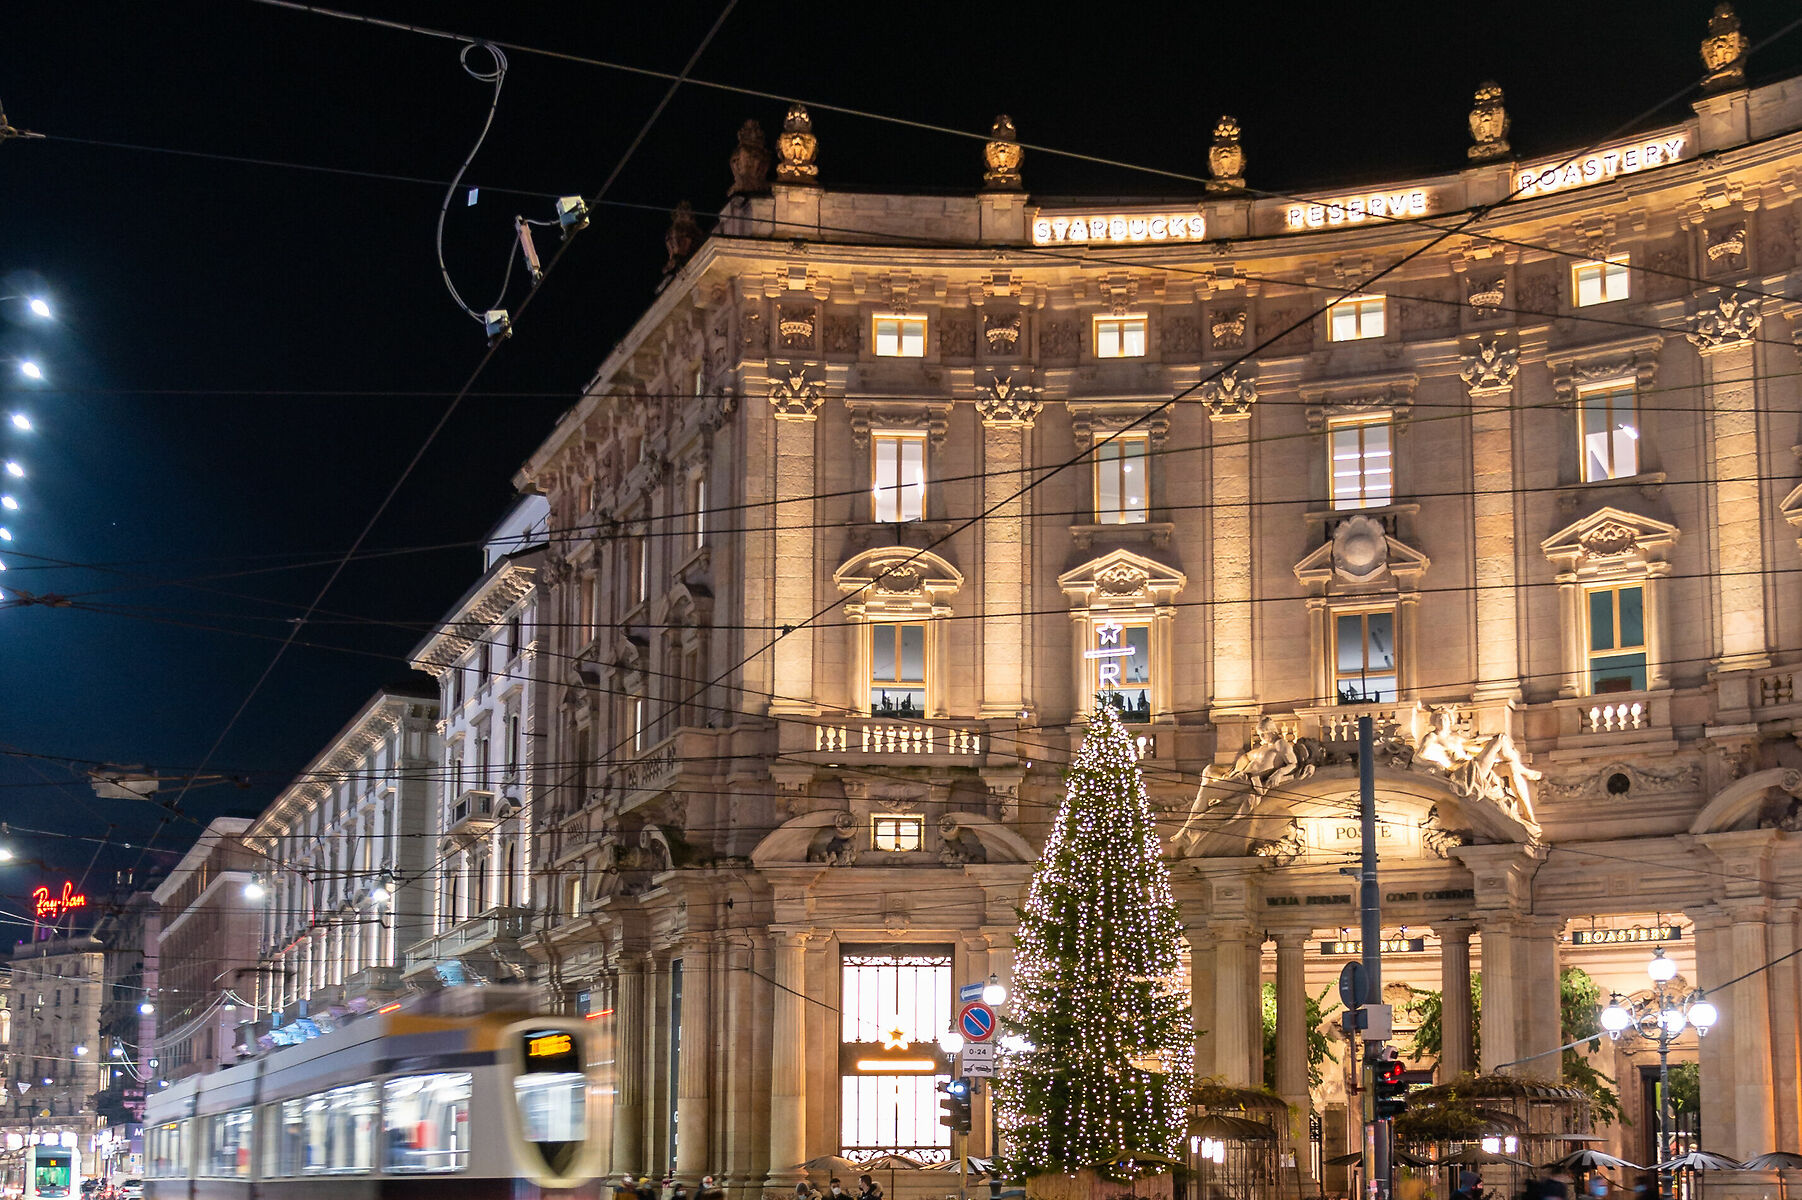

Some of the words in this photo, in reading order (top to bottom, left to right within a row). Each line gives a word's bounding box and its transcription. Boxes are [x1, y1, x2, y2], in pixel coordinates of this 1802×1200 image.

[1520, 139, 1680, 189] ROASTERY
[1289, 192, 1423, 226] RESERVE
[1036, 215, 1203, 241] STARBUCKS
[1334, 939, 1410, 954] RESRVE
[1581, 927, 1671, 944] ROASTERY
